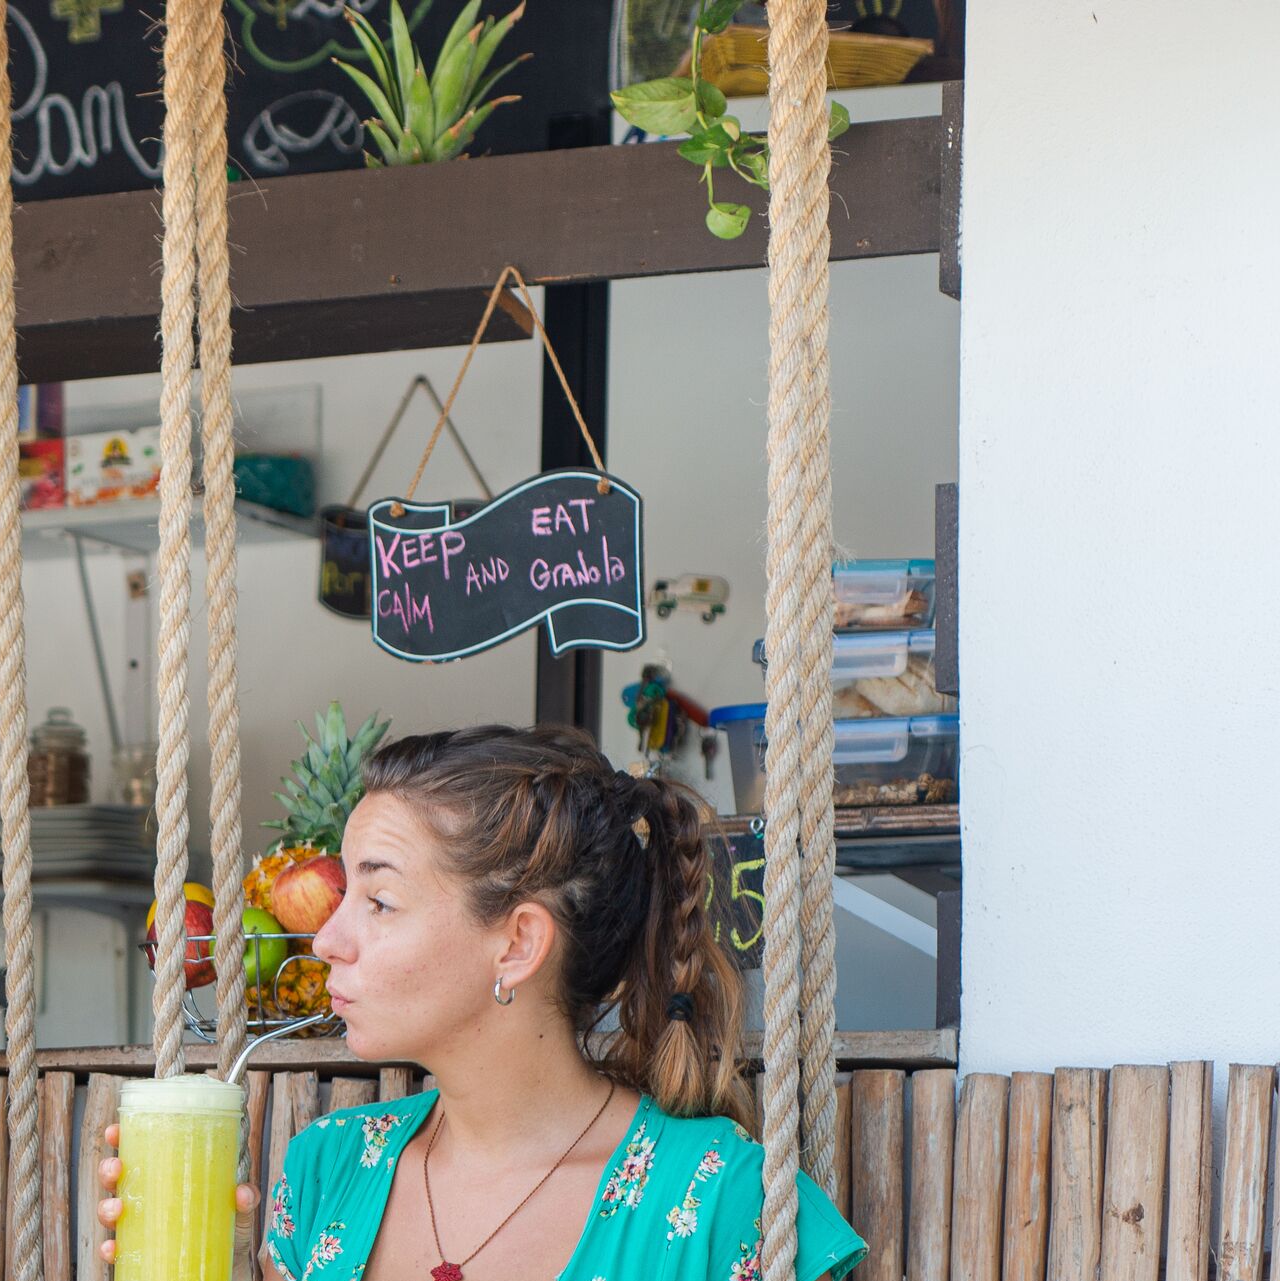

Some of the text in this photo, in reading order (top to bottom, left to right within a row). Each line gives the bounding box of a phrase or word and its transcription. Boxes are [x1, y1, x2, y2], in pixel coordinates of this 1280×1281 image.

[531, 499, 595, 536] EAT
[376, 531, 466, 580] KEEP
[464, 556, 510, 596] AND
